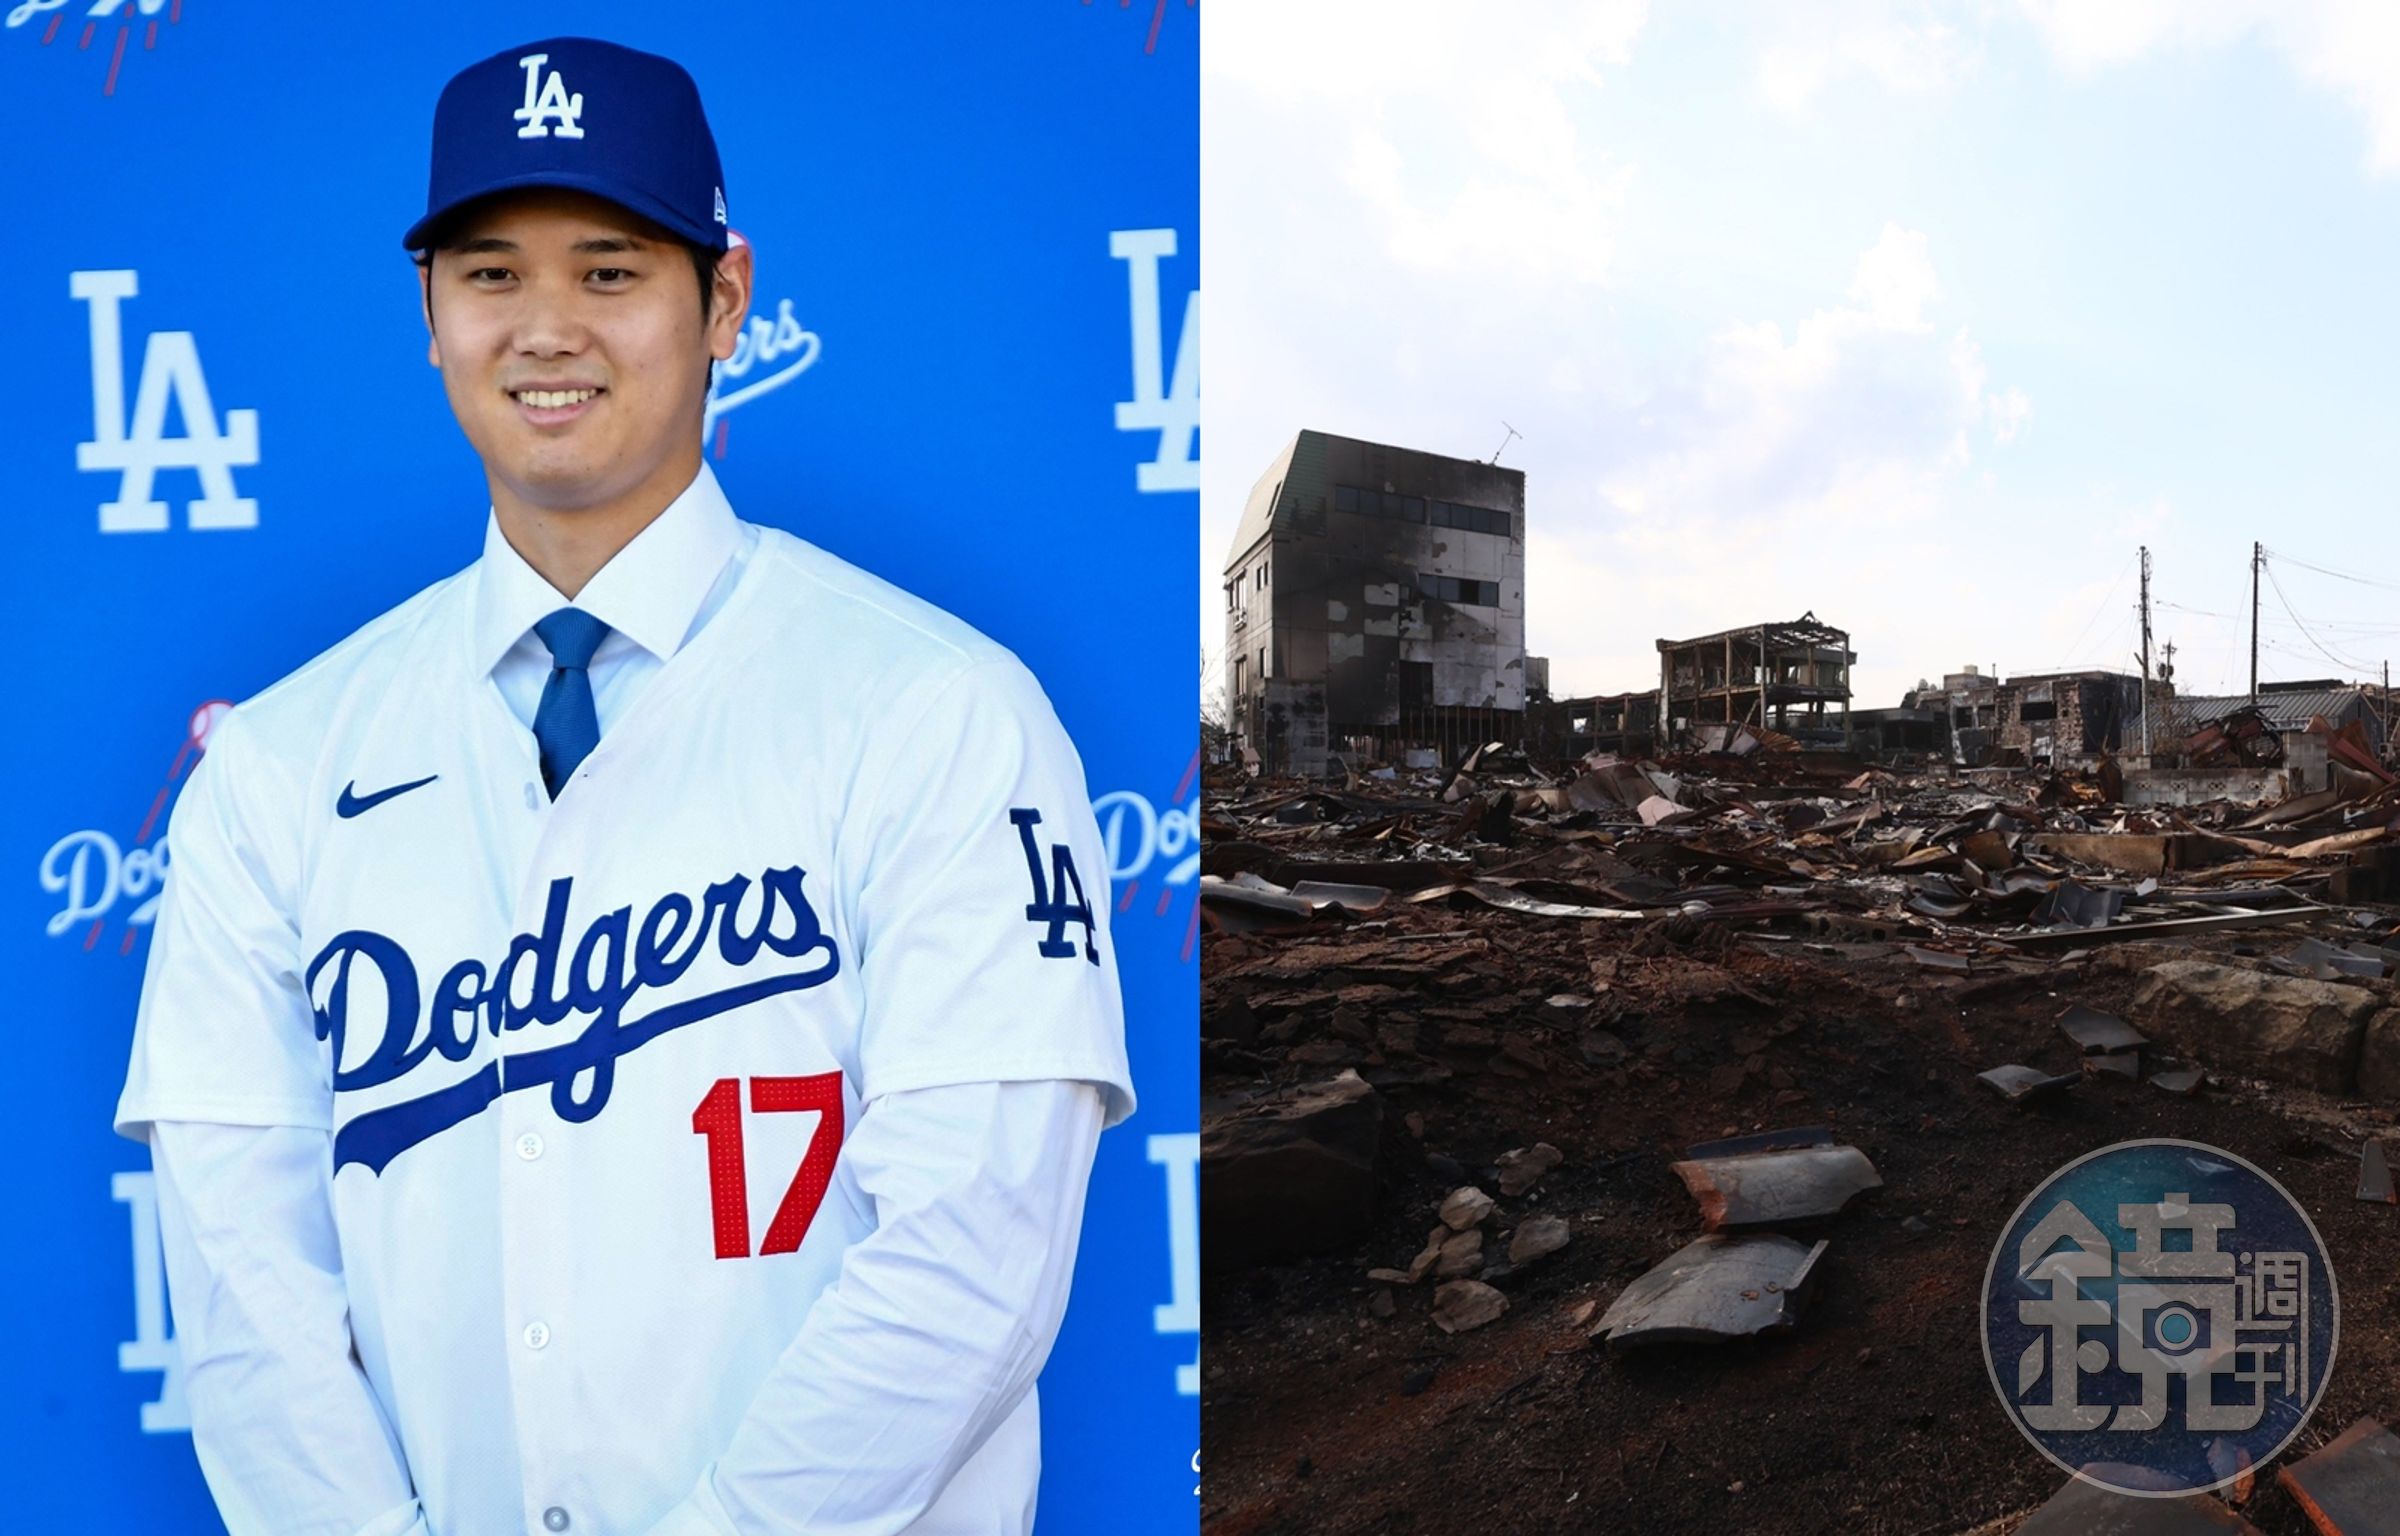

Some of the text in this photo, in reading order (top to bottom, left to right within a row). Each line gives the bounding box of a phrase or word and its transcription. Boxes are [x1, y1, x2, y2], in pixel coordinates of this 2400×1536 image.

[513, 52, 585, 140] LA
[69, 269, 260, 533] LA
[1009, 807, 1101, 968] LA
[305, 865, 840, 1178] Dodgers
[691, 1069, 845, 1261] 17
